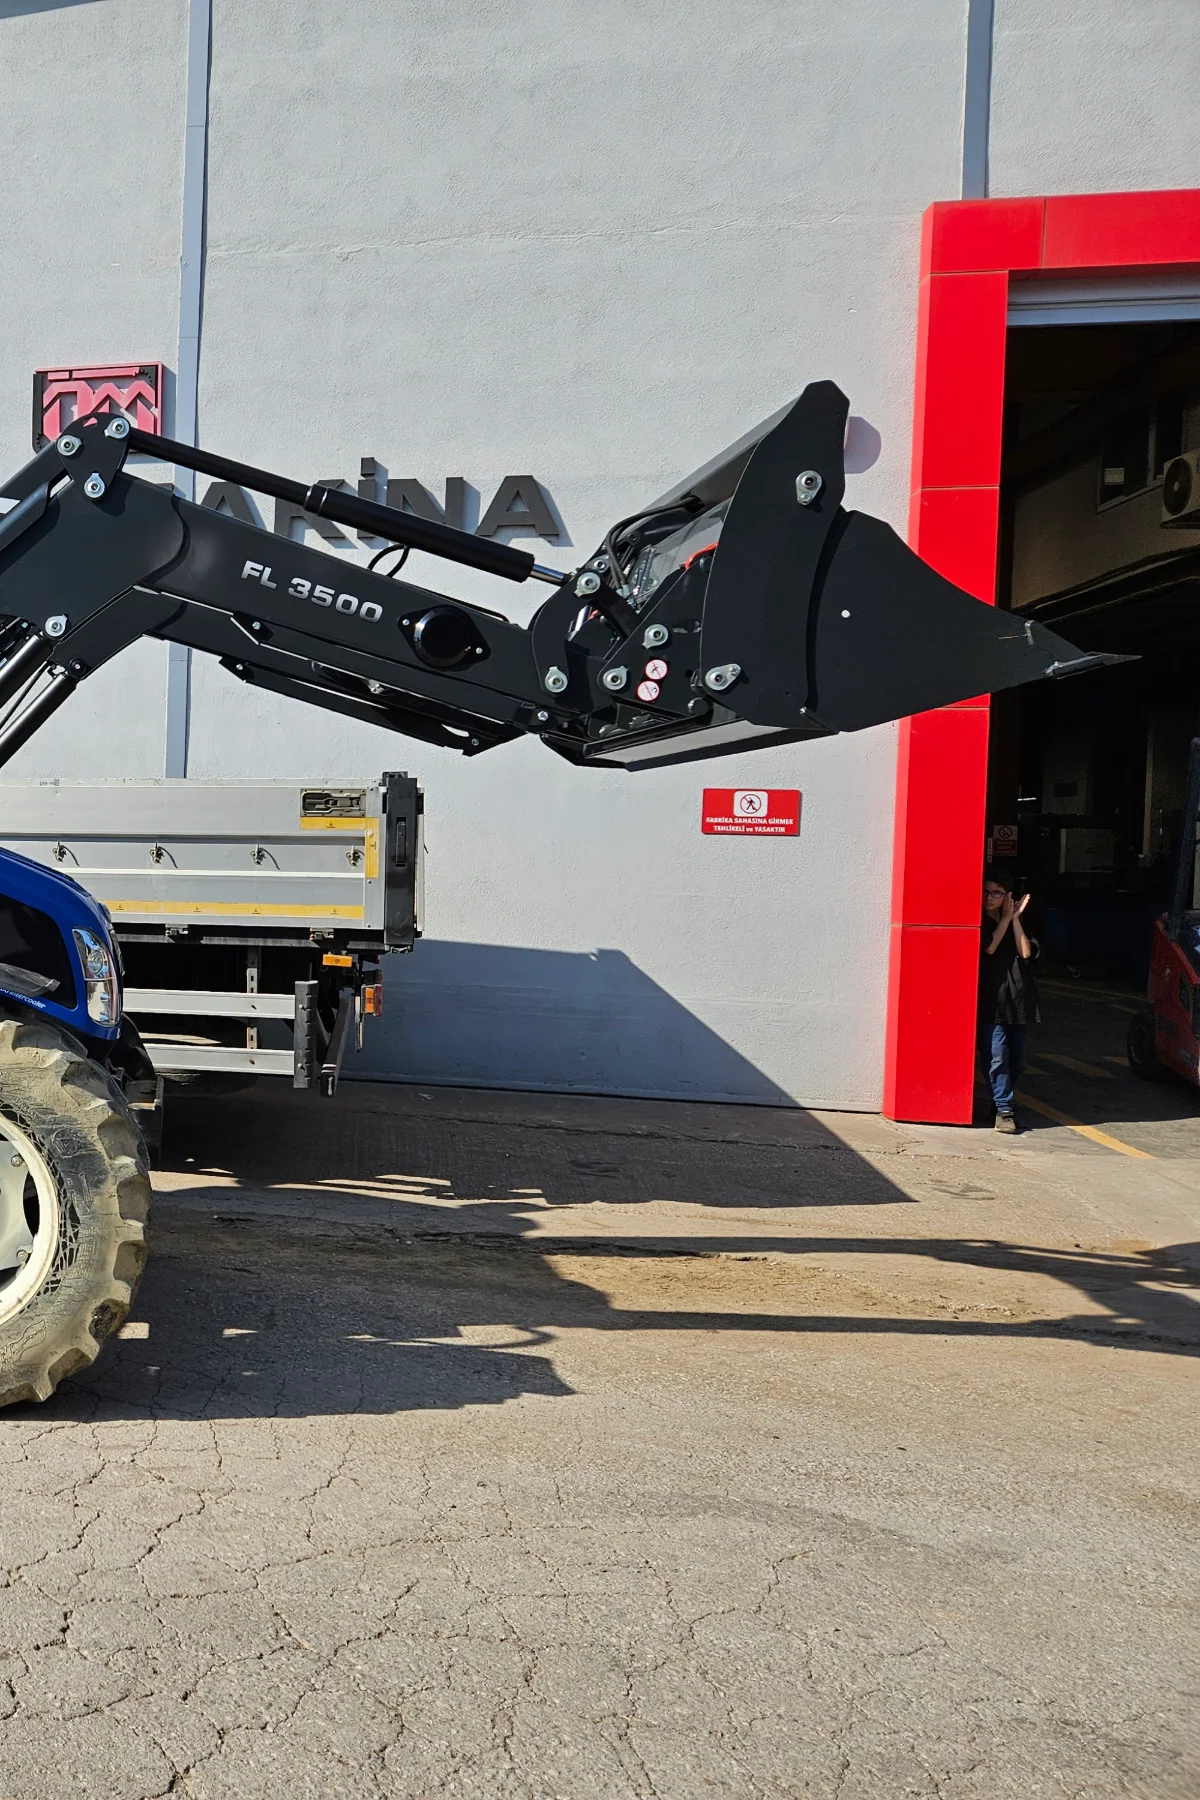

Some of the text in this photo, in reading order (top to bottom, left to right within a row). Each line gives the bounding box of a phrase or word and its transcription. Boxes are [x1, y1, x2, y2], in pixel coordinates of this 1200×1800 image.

[152, 457, 560, 540] AKİNA
[240, 560, 384, 623] FL 3500
[706, 816, 733, 824] FABRİKA
[768, 817, 794, 825] GİRMEK
